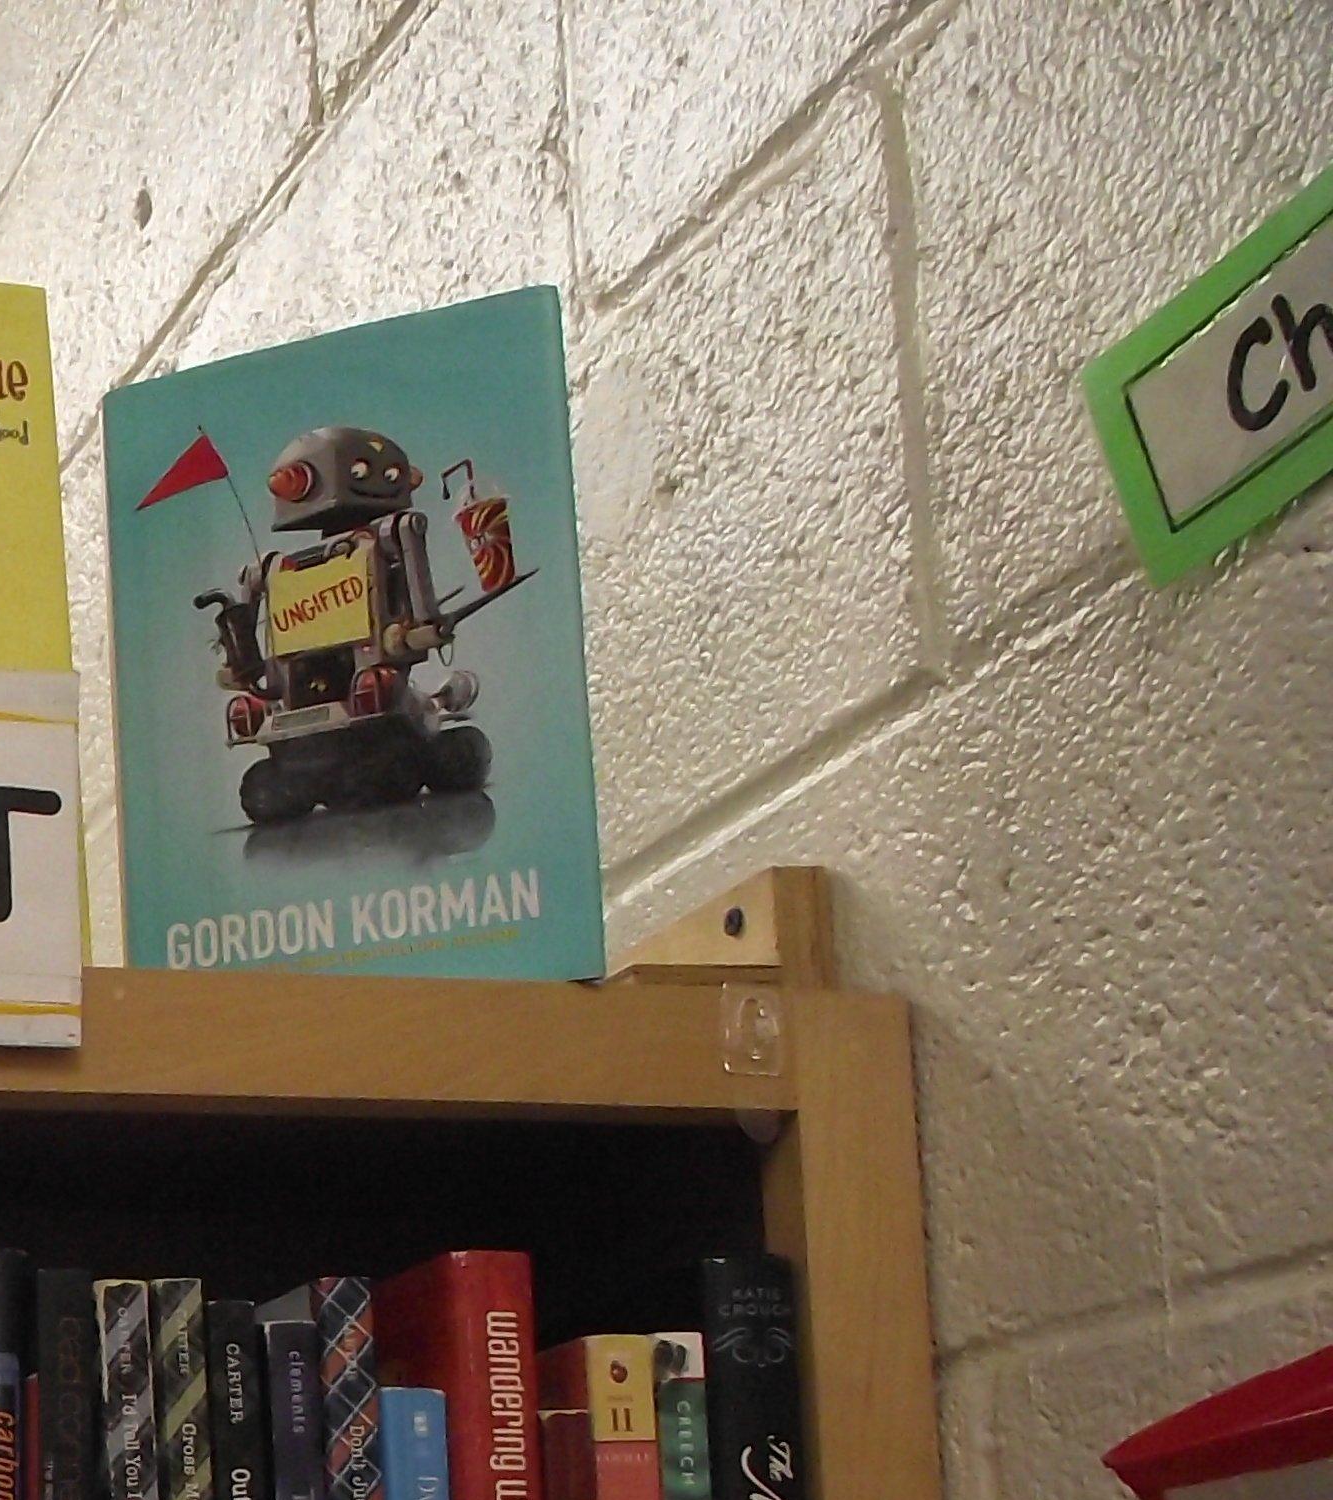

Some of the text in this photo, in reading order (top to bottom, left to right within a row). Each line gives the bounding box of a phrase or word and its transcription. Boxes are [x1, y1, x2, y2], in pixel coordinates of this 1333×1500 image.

[272, 576, 364, 634] UNGIFTED
[167, 898, 334, 969] GORDON
[352, 869, 541, 945] KORMAN
[485, 1310, 529, 1471] wandering
[765, 1434, 795, 1482] The
